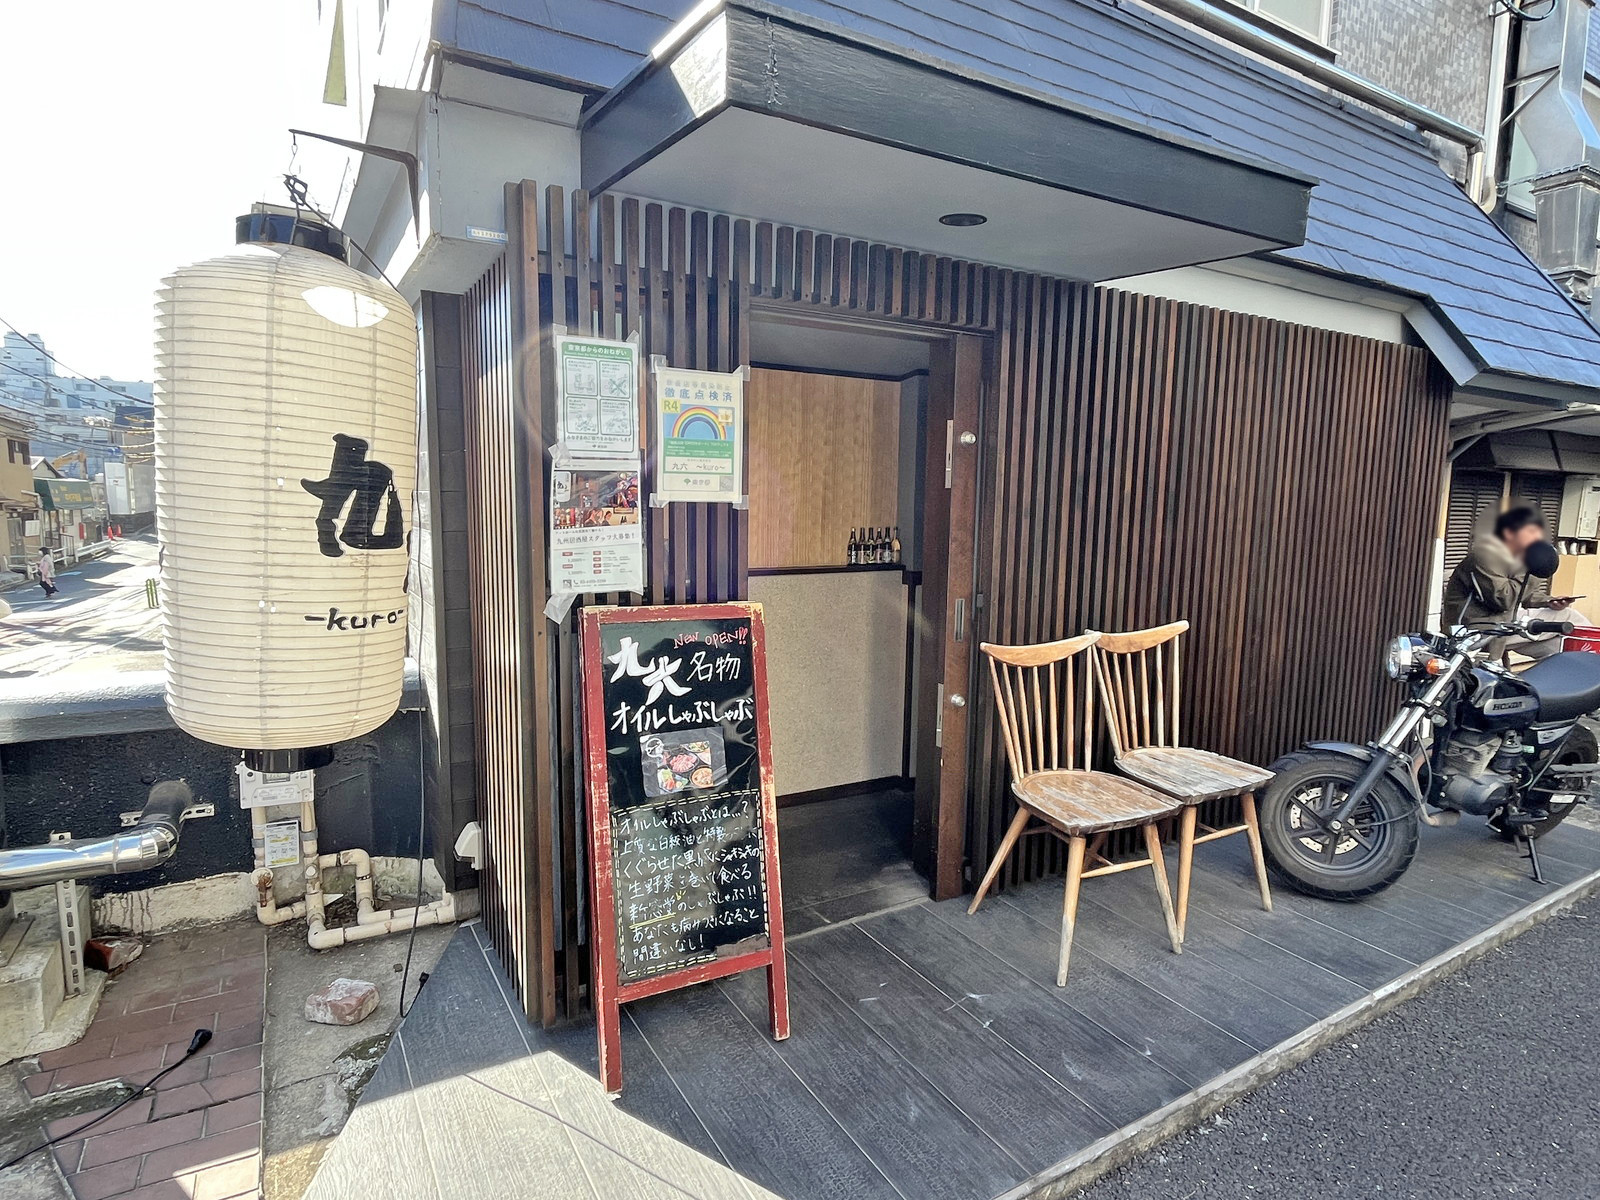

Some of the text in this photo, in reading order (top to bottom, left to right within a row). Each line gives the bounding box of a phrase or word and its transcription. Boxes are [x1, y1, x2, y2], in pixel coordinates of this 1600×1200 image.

[664, 387, 733, 402] 徹底点検済
[663, 400, 679, 411] R4
[671, 462, 688, 470] 九六
[674, 632, 700, 649] NEW
[686, 651, 741, 682] 名物
[610, 697, 753, 734] オイルしゃぶしゃぶ
